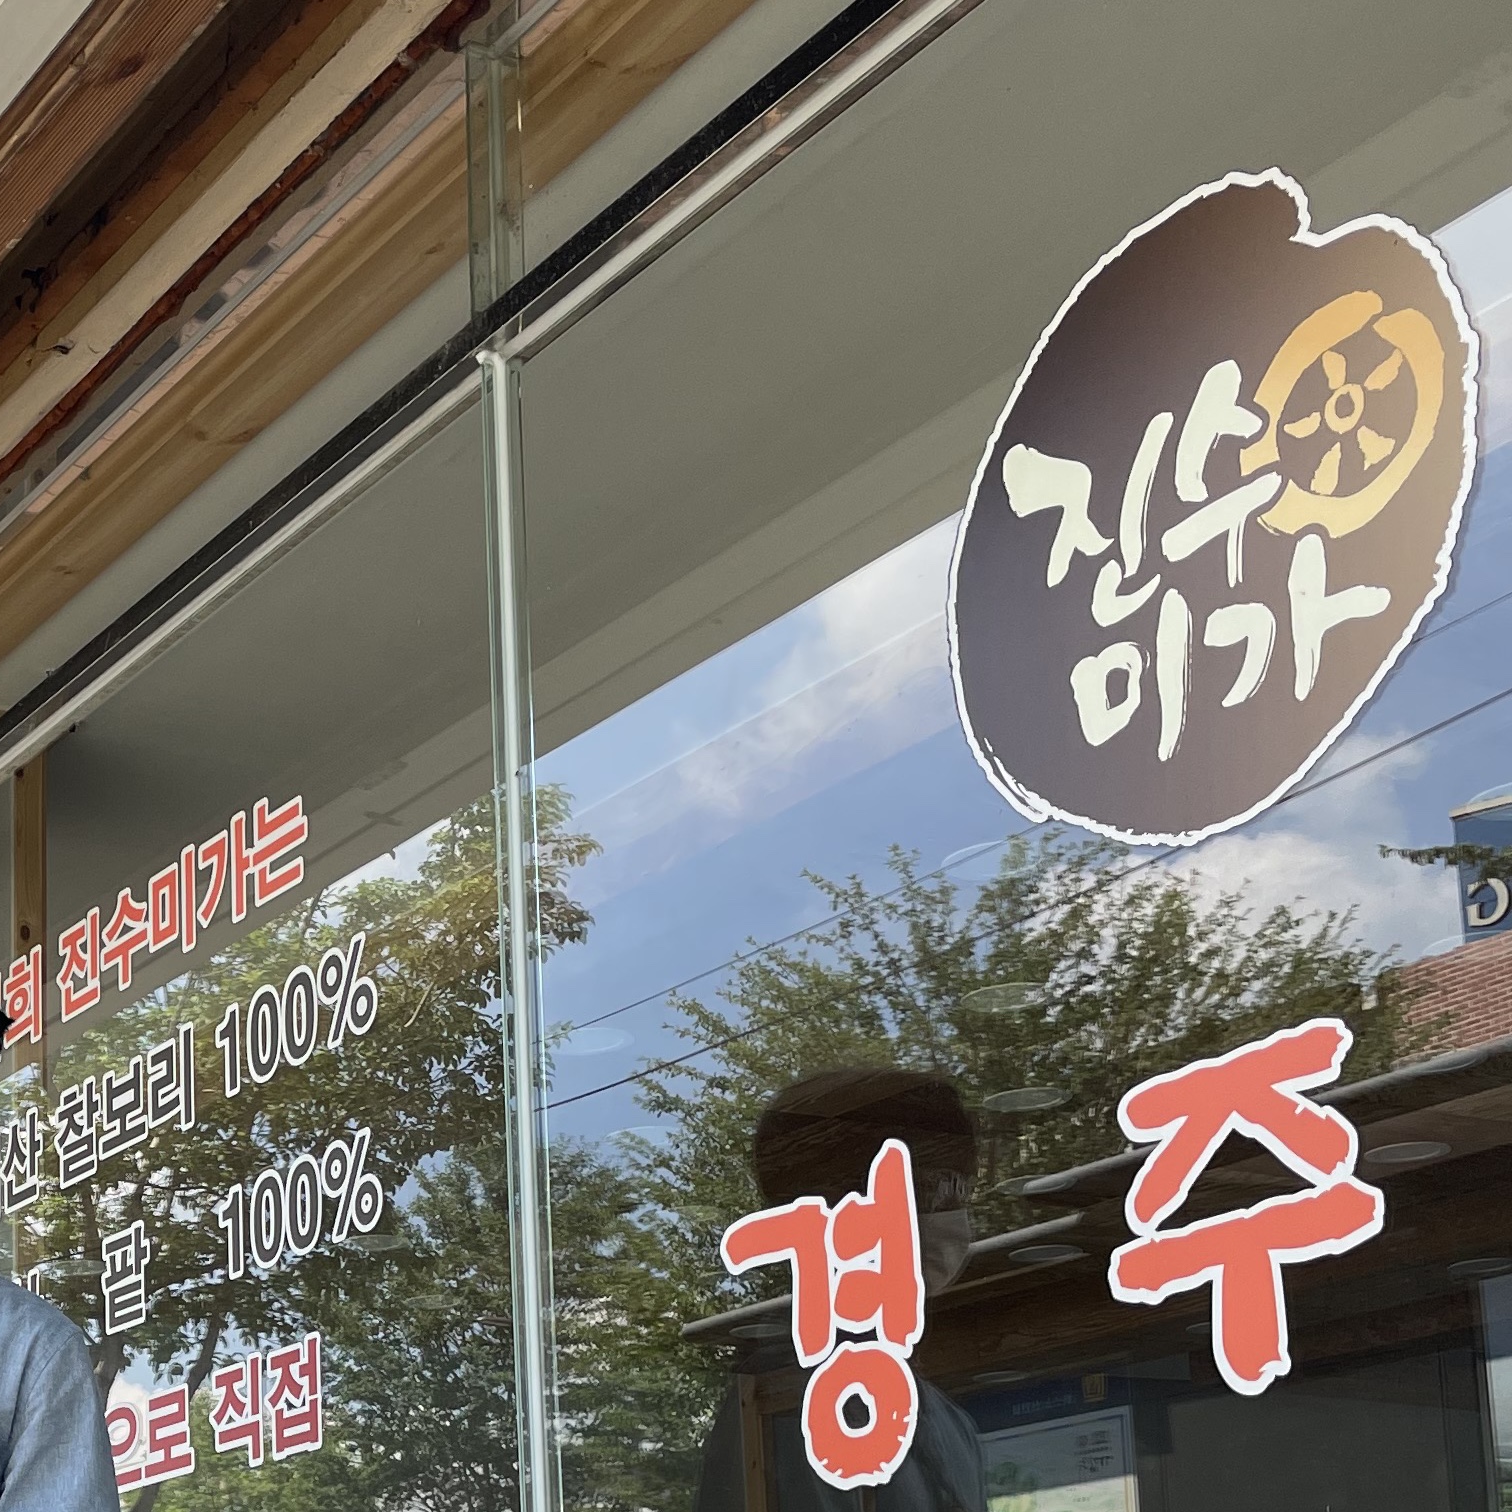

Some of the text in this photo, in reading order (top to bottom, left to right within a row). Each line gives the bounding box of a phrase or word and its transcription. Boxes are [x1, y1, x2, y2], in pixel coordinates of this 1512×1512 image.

[1070, 534, 1391, 762] 미가
[56, 796, 308, 1022] 진수미가는
[54, 1022, 194, 1191] 찰보리
[215, 932, 378, 1099] 100%
[101, 1127, 383, 1335] 팥 100%
[209, 1331, 322, 1468] 직접
